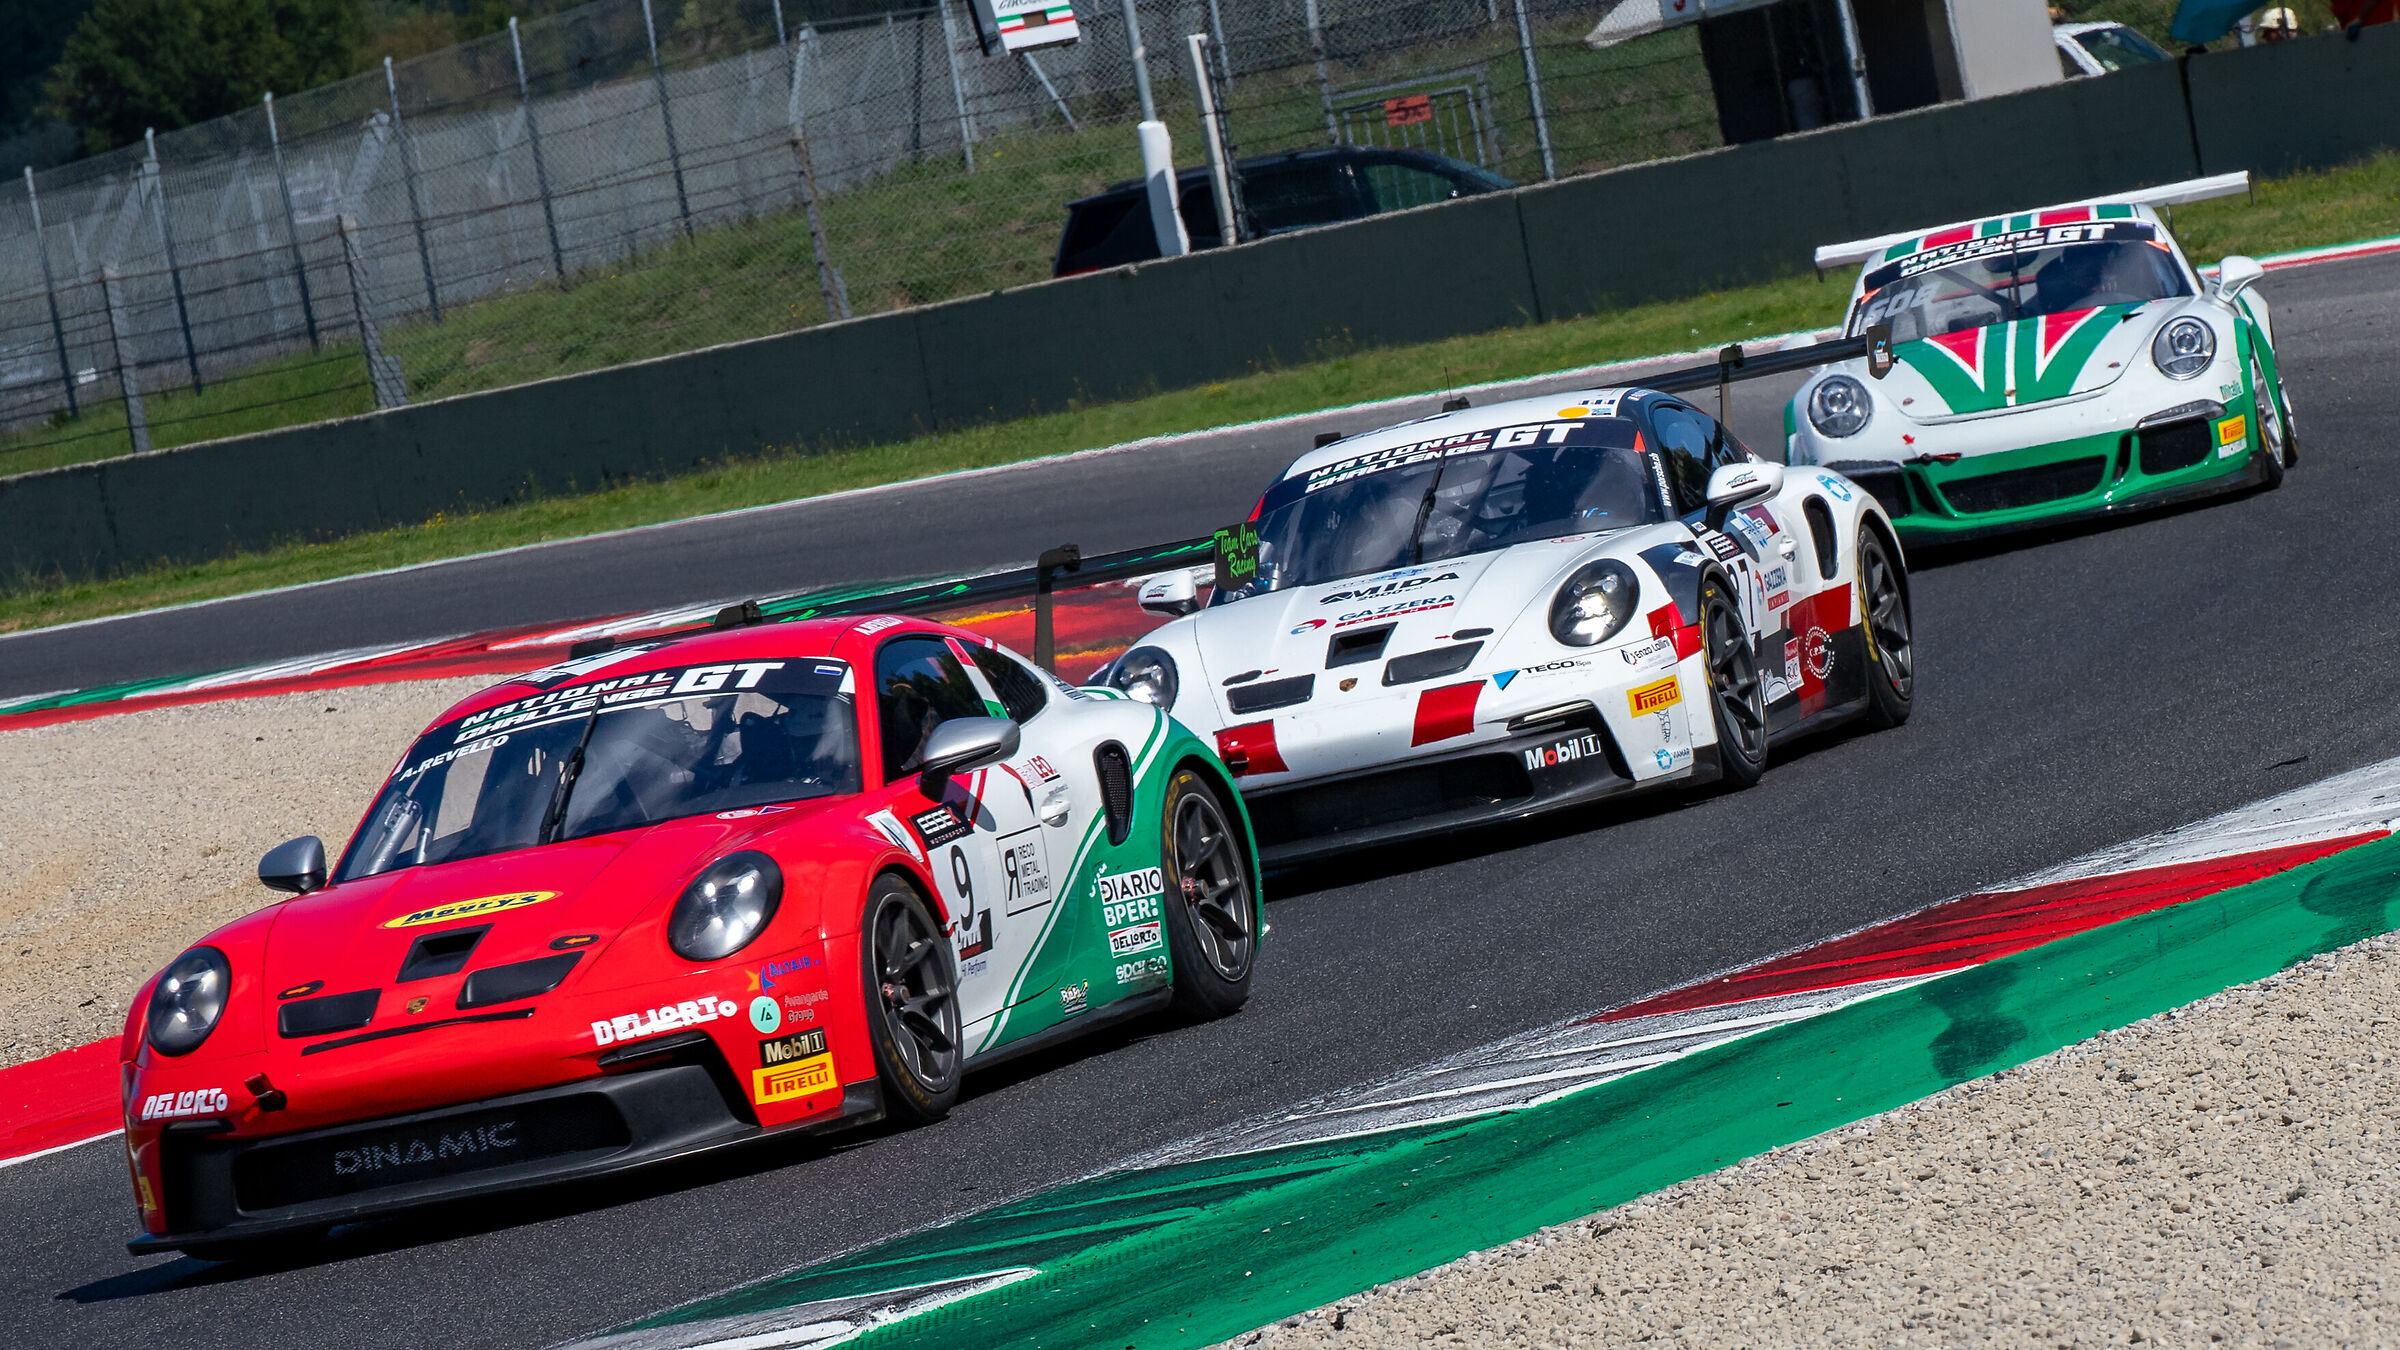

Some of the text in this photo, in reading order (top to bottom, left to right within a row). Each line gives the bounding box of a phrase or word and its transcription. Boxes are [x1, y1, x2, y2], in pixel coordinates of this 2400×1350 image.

[1900, 237, 2045, 278] CHALLENGE
[1902, 223, 2115, 268] NATIONAL GT
[1305, 441, 1490, 494] CHALLENGE
[1308, 422, 1585, 480] NATIONAL GT
[1350, 572, 1460, 598] MIDA
[1338, 594, 1456, 622] GAZZERA
[1521, 661, 1575, 674] TECO
[453, 685, 670, 745] CHALLENGE
[460, 672, 675, 730] NATIONAL
[670, 662, 786, 695] GT
[1634, 681, 1678, 711] PIRELLI
[398, 735, 510, 782] A.REVELLO
[1525, 738, 1582, 771] Mobil
[950, 844, 974, 932] 9
[1101, 869, 1162, 903] DIARIO
[404, 894, 539, 924] Maurys
[766, 1032, 811, 1063] Mobil
[763, 1062, 828, 1097] PIRELLI
[333, 1120, 517, 1176] DINAMIC
